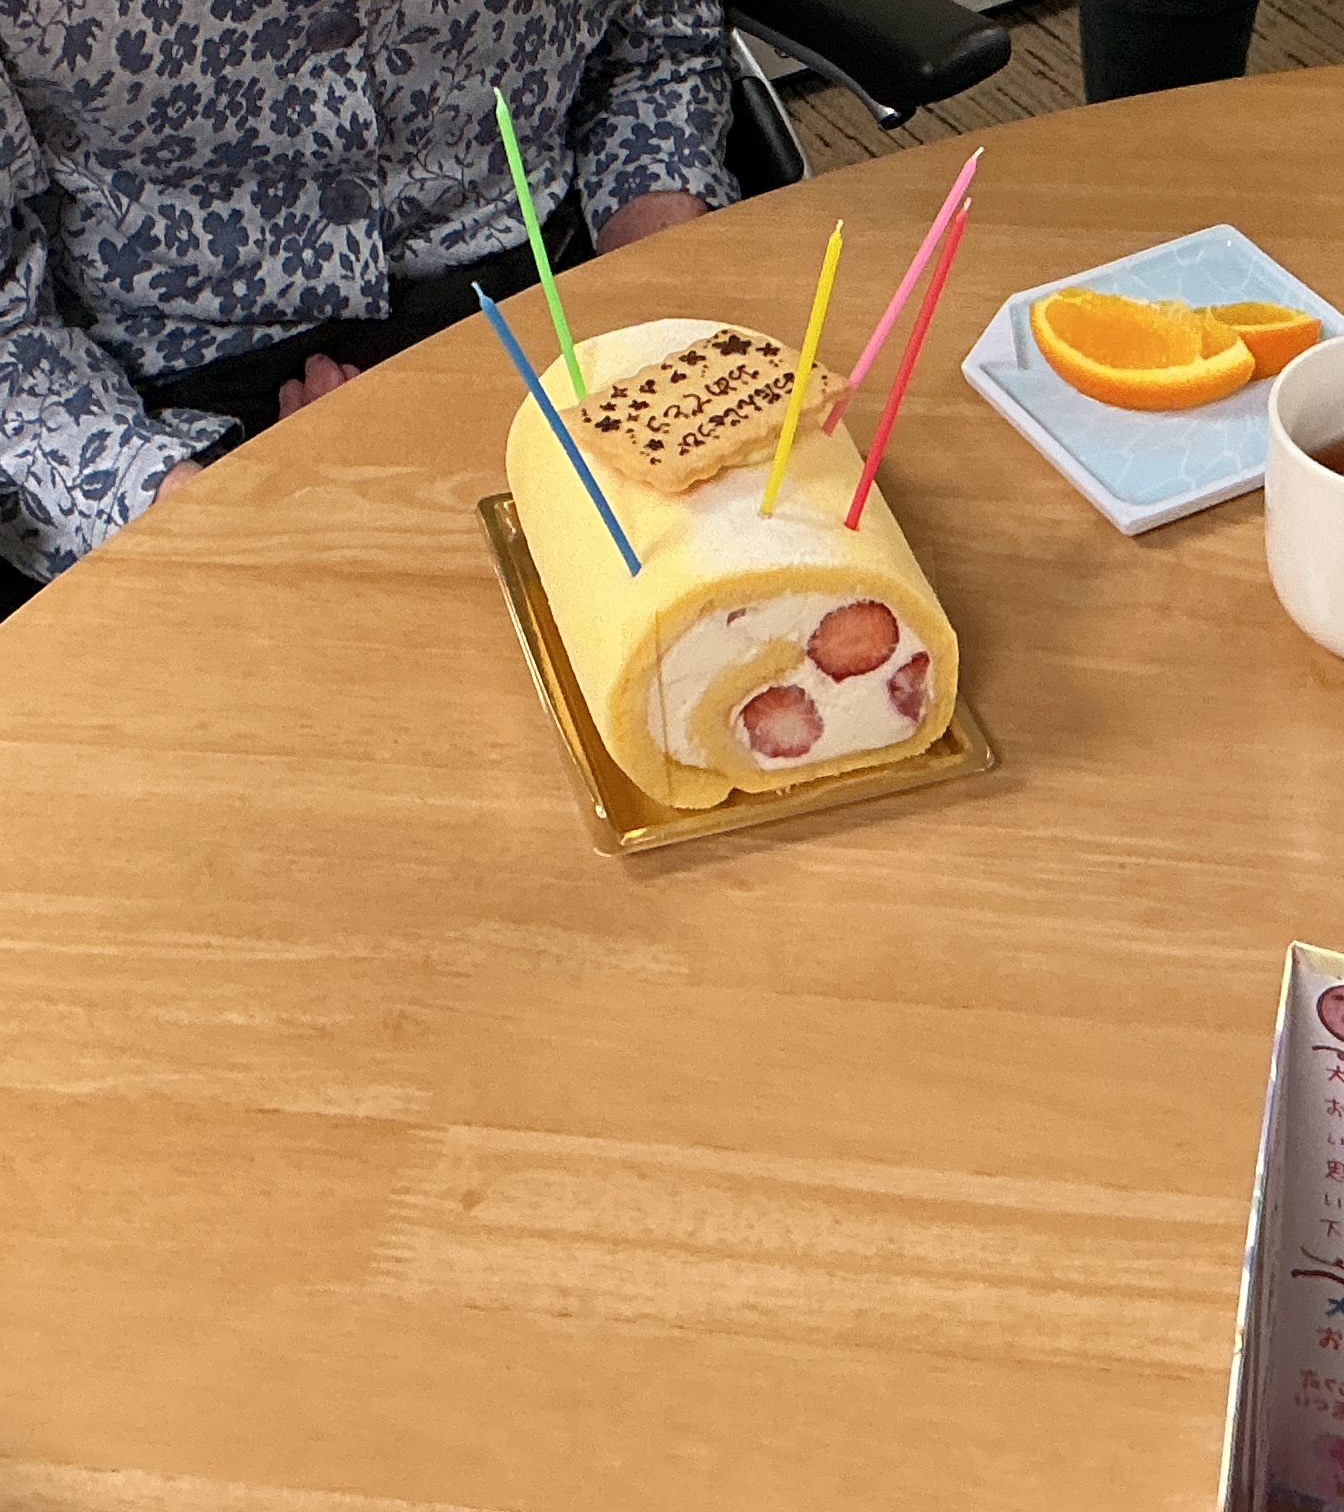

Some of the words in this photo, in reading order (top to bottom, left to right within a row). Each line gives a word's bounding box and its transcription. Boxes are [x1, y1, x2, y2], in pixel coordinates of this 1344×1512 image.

[646, 364, 760, 434] おめでとう
